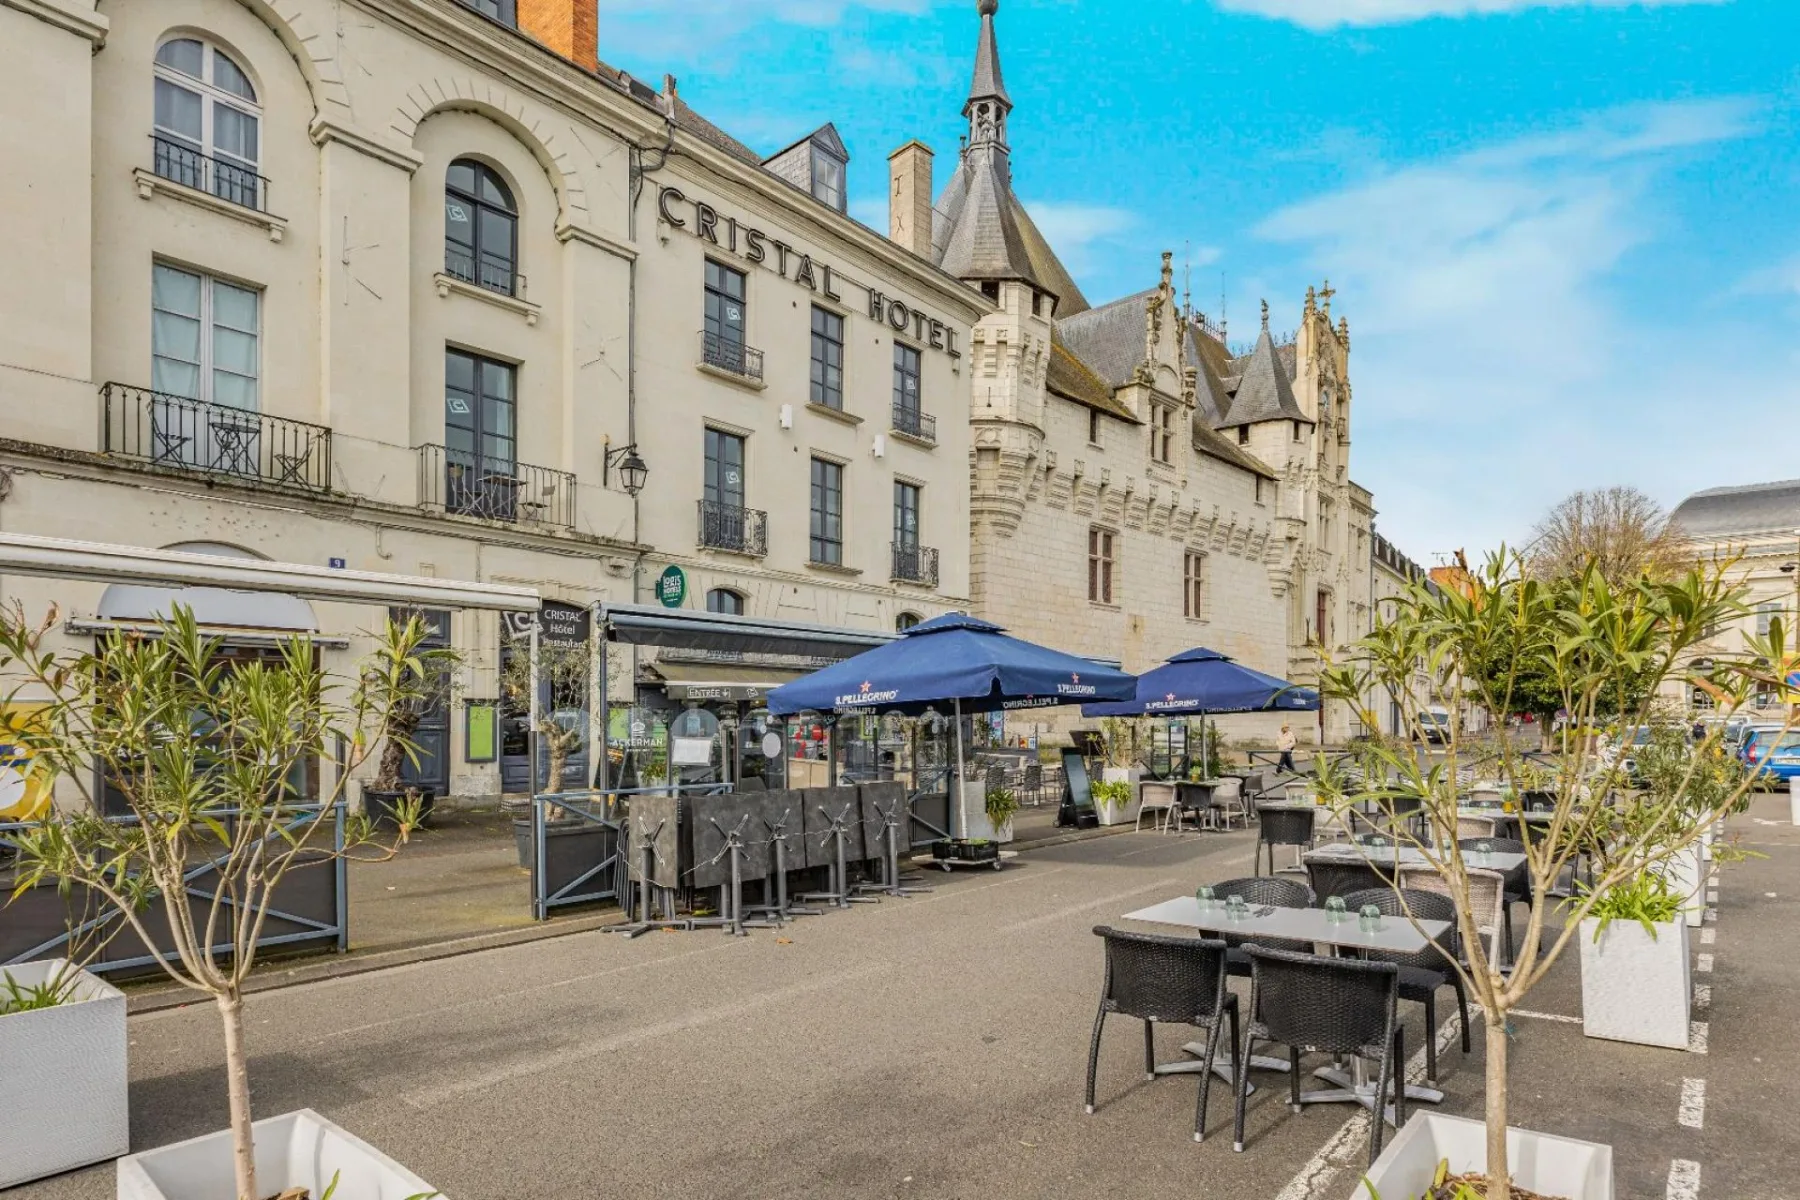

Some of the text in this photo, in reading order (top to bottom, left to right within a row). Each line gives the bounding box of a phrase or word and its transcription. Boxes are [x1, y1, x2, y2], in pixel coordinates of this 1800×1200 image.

[658, 186, 962, 359] CRISTAL HOTEL
[334, 559, 341, 568] 9
[544, 609, 582, 623] CRISTAL
[550, 623, 576, 635] Hôtel
[835, 690, 899, 705] S.PELLEGRINO
[1145, 699, 1200, 710] S.PELLEGRINO
